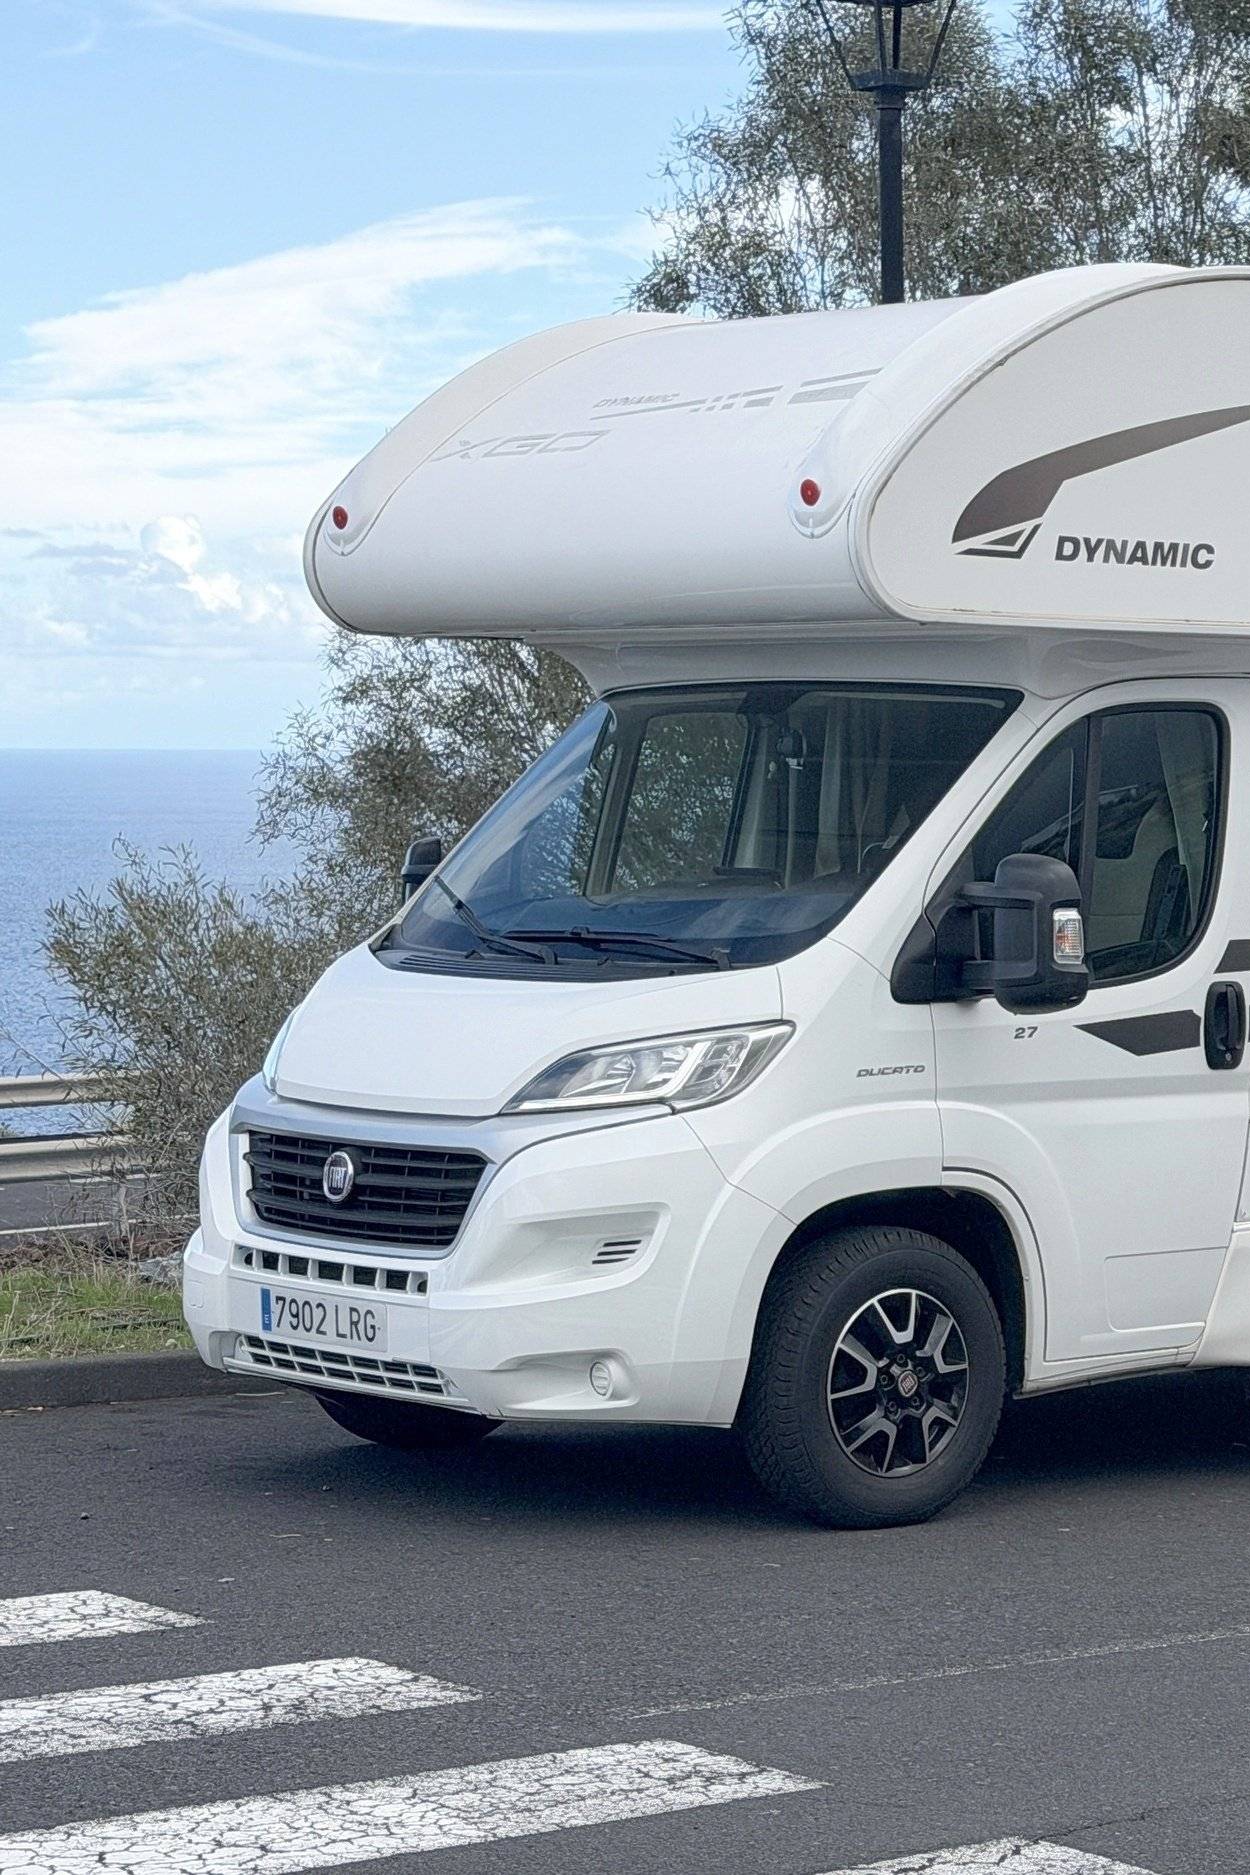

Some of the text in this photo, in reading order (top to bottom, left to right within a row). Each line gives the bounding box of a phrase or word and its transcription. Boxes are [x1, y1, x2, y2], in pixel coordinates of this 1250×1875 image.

[429, 429, 612, 462] XGO
[1054, 535, 1216, 570] DYNAMIC
[1014, 1026, 1038, 1039] 27
[856, 1065, 925, 1077] DUCATO
[328, 1166, 347, 1189] FIAT
[275, 1296, 377, 1343] 7902 LRG
